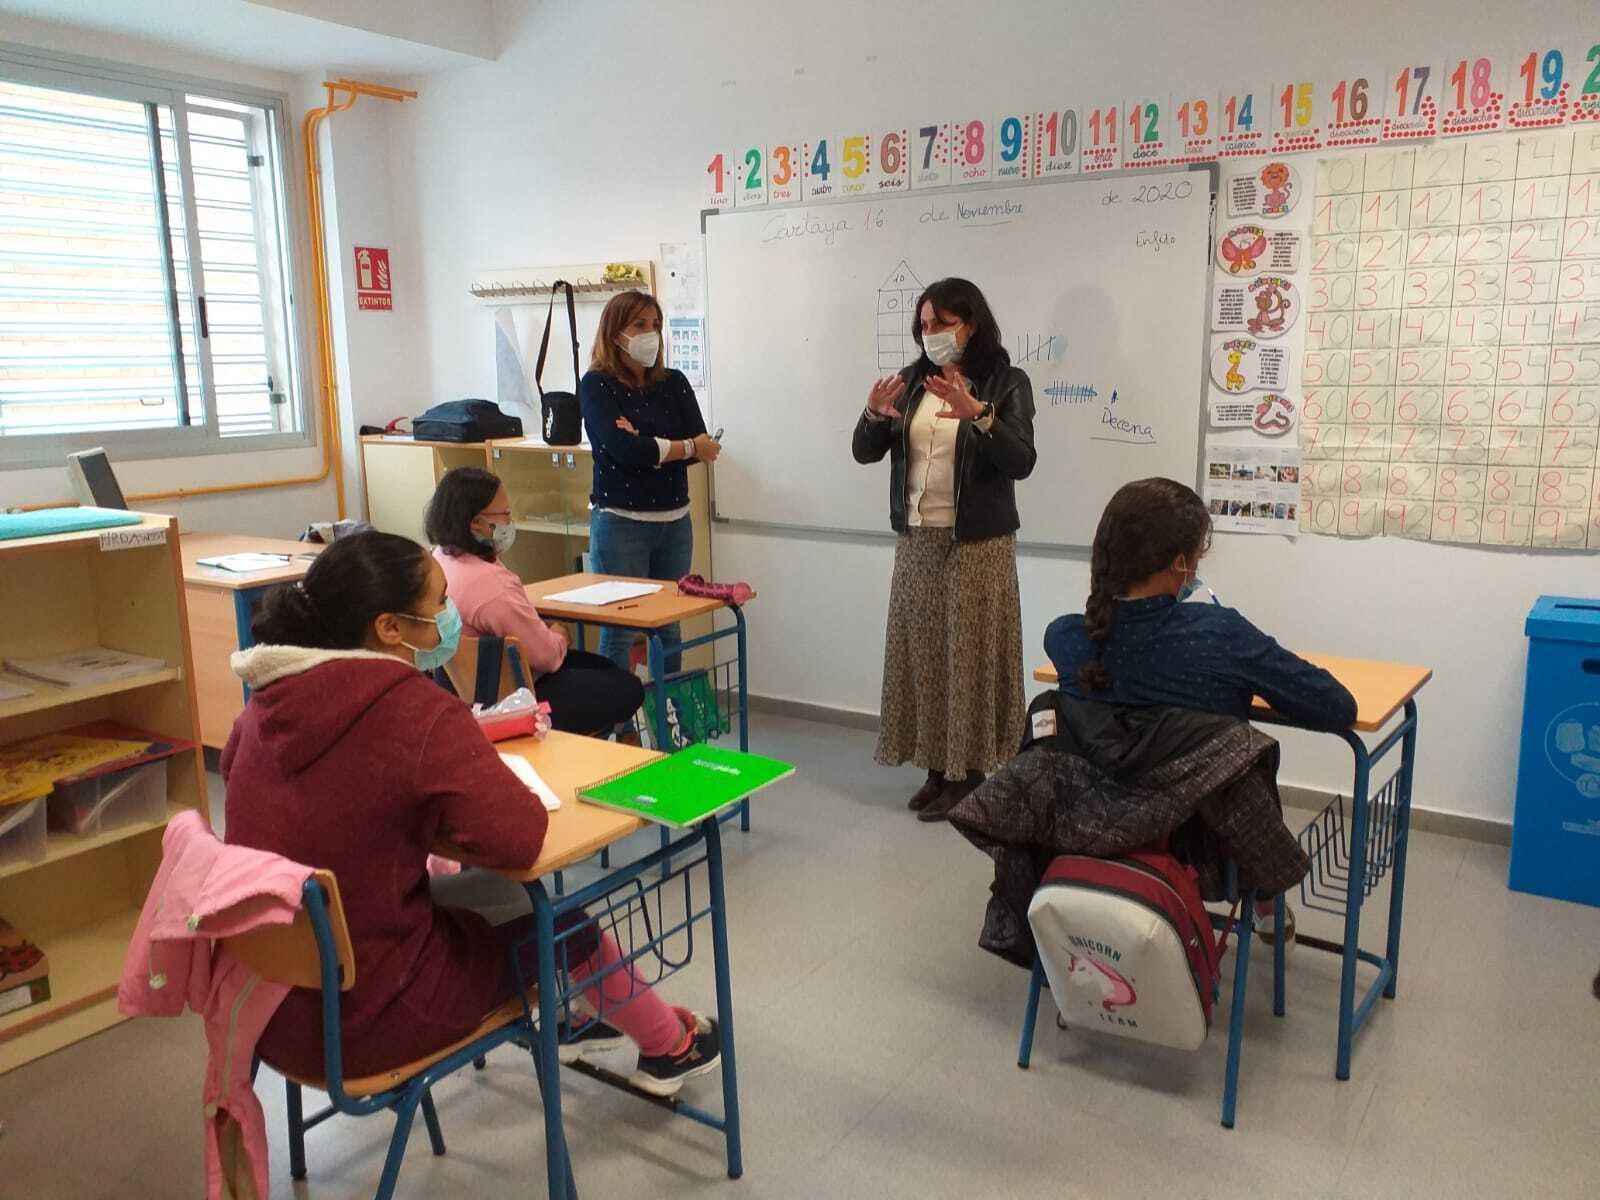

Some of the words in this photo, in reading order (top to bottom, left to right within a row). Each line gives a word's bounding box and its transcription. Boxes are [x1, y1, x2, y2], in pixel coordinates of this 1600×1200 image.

[1395, 67, 1431, 116] 17
[1451, 58, 1492, 110] 18
[1520, 50, 1563, 104] 19
[1178, 100, 1209, 137] 13
[1225, 94, 1253, 133] 14
[1280, 83, 1314, 128] 15
[1331, 78, 1369, 122] 16
[964, 120, 985, 165] 8
[1000, 117, 1022, 162] 9
[1046, 110, 1077, 157] 10
[1089, 107, 1117, 145] 11
[1130, 104, 1159, 144] 12
[773, 147, 791, 186] 3
[811, 140, 830, 181] 4
[843, 137, 865, 178] 5
[880, 133, 901, 174] 6
[919, 126, 938, 169] 7
[1132, 147, 1159, 160] doce
[707, 154, 724, 193] 1
[745, 149, 762, 189] 2
[962, 168, 986, 178] ocho
[1132, 180, 1193, 203] 2020
[1317, 198, 1356, 234] 10
[1365, 192, 1400, 227] 11
[1414, 190, 1453, 225] 12
[1469, 184, 1503, 221] 13
[1522, 180, 1563, 216] 14
[1312, 237, 1355, 271] 20
[1363, 233, 1402, 268] 21
[1408, 229, 1454, 265] 22
[1458, 225, 1504, 262] 23
[1510, 221, 1559, 259] 24
[1310, 274, 1353, 308] 30
[1356, 273, 1397, 307] 31
[1407, 270, 1451, 305] 32
[1455, 267, 1501, 302] 33
[1508, 264, 1552, 301] 34
[1307, 312, 1350, 345] 40
[1357, 311, 1393, 345] 41
[1404, 310, 1448, 346] 42
[1455, 309, 1500, 342] 43
[1506, 305, 1552, 344] 44
[1304, 352, 1348, 384] 50
[1352, 350, 1391, 383] 51
[1398, 349, 1442, 383] 52
[1449, 347, 1496, 382] 53
[1500, 346, 1548, 383] 54
[1552, 346, 1600, 383] 55
[1303, 390, 1345, 424] 60
[1350, 389, 1390, 424] 61
[1397, 389, 1441, 423] 62
[1447, 389, 1492, 423] 63
[1498, 389, 1543, 424] 64
[1551, 388, 1597, 424] 65
[1303, 426, 1343, 458] 70
[1350, 426, 1388, 459] 71
[1396, 426, 1439, 460] 72
[1446, 427, 1487, 462] 73
[1497, 428, 1539, 464] 74
[1546, 428, 1596, 464] 75
[1300, 463, 1340, 494] 80
[1344, 463, 1383, 495] 81
[1390, 465, 1434, 497] 82
[1440, 466, 1482, 500] 83
[1490, 469, 1536, 502] 84
[1541, 470, 1588, 504] 85
[1300, 499, 1336, 530] 90
[1343, 500, 1380, 537] 91
[1387, 503, 1430, 537] 92
[1437, 505, 1481, 541] 93
[1487, 508, 1532, 544] 94
[1538, 510, 1587, 546] 95
[1069, 935, 1122, 961] UNICORN
